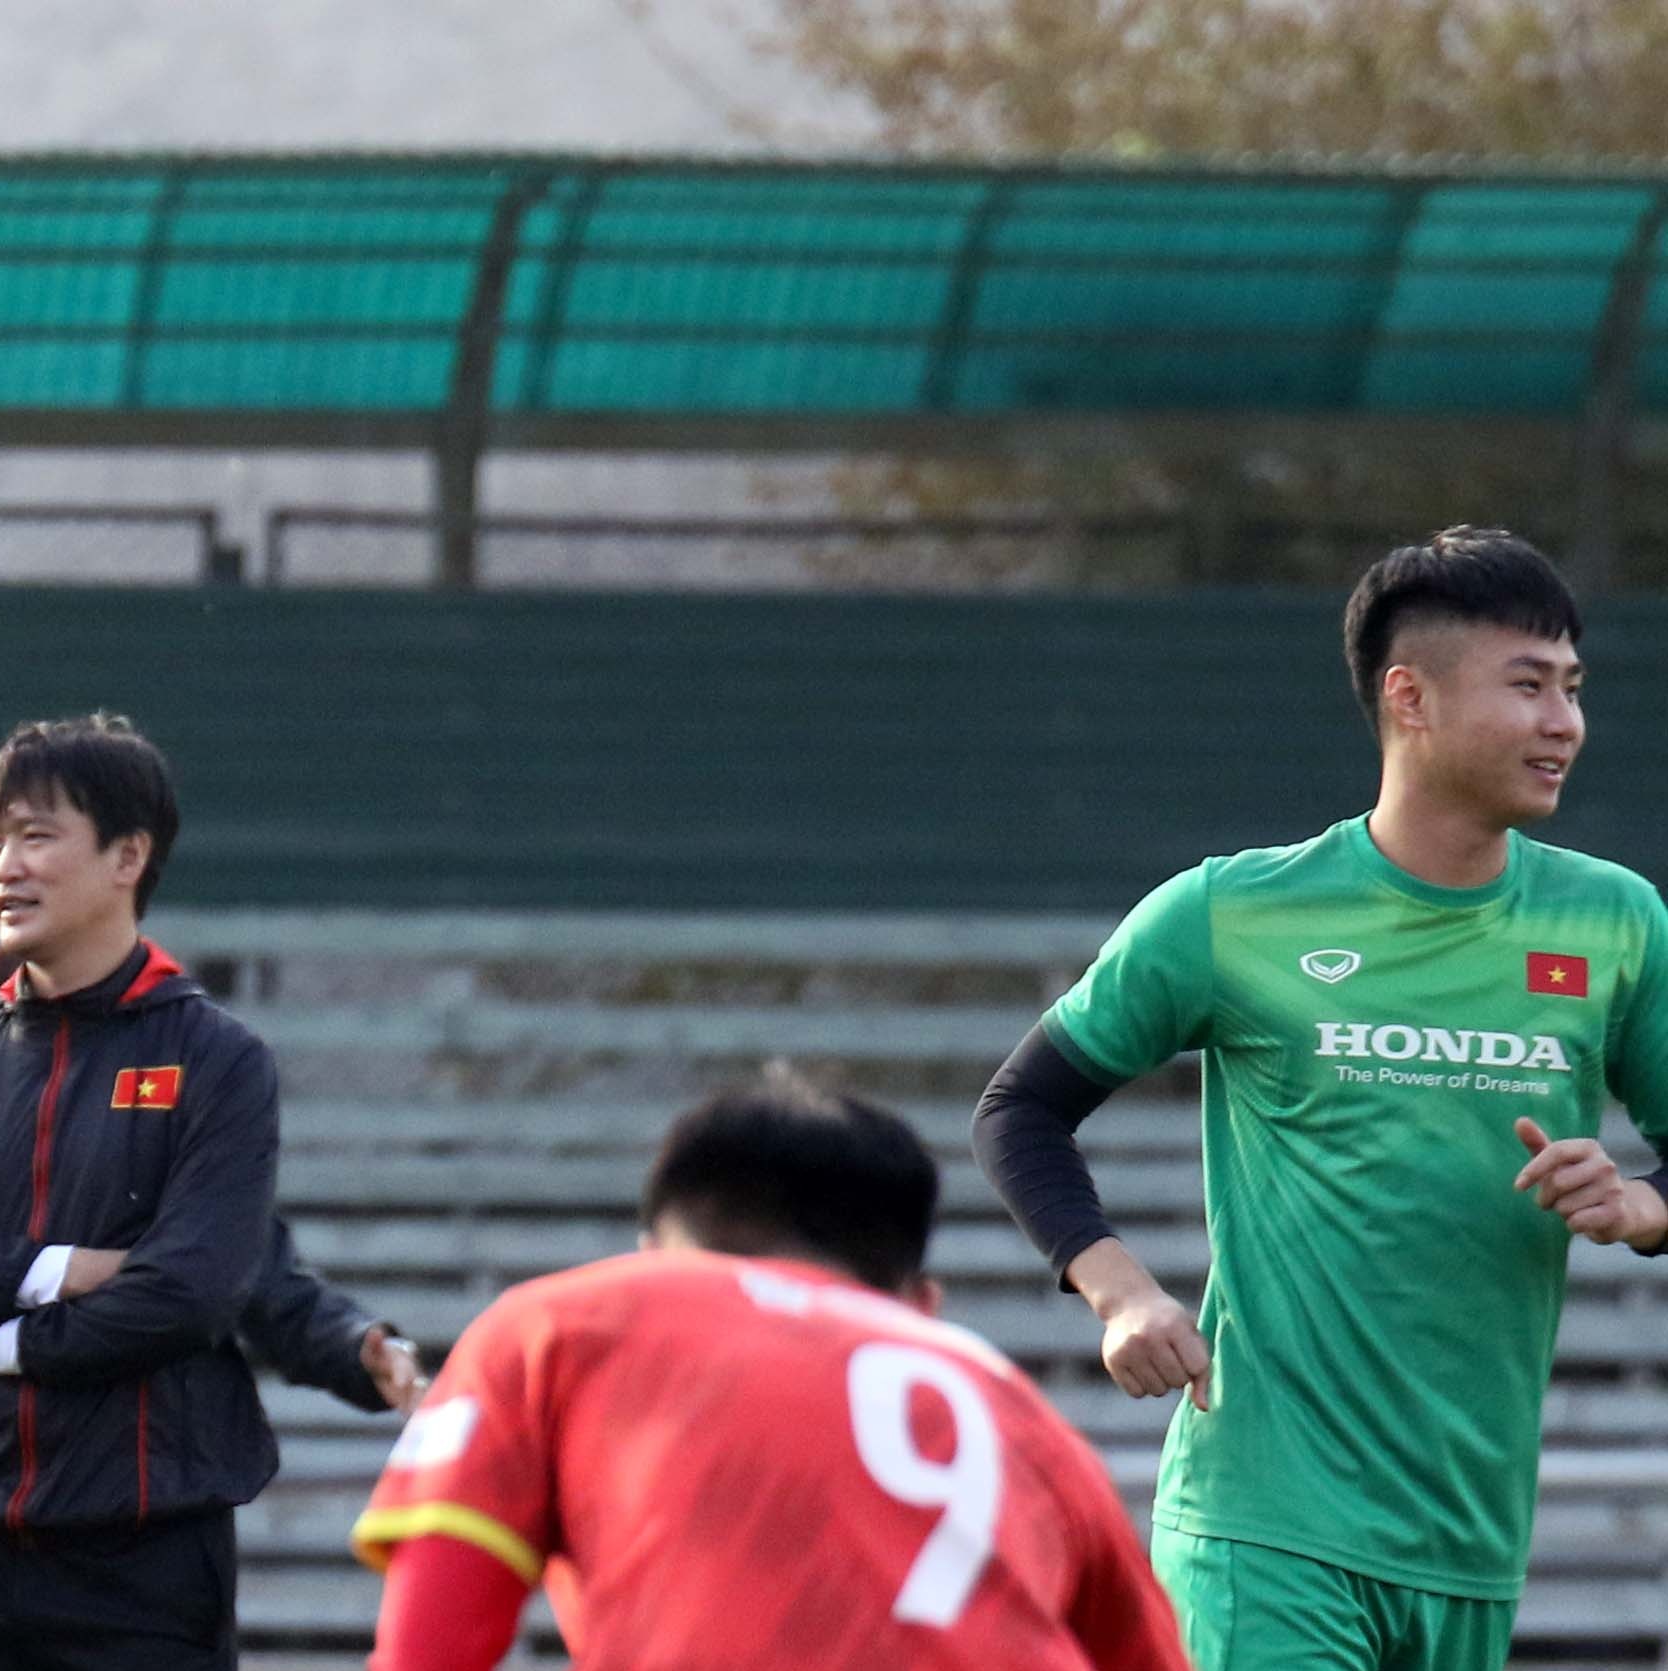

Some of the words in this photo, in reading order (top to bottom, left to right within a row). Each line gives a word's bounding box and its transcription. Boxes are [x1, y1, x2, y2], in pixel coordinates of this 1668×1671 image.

[1314, 1021, 1572, 1072] HONDA
[1335, 1065, 1373, 1083] The
[1378, 1067, 1444, 1088] Power
[1447, 1071, 1471, 1089] of
[1474, 1074, 1550, 1096] Dreams
[847, 1341, 1002, 1629] 9
